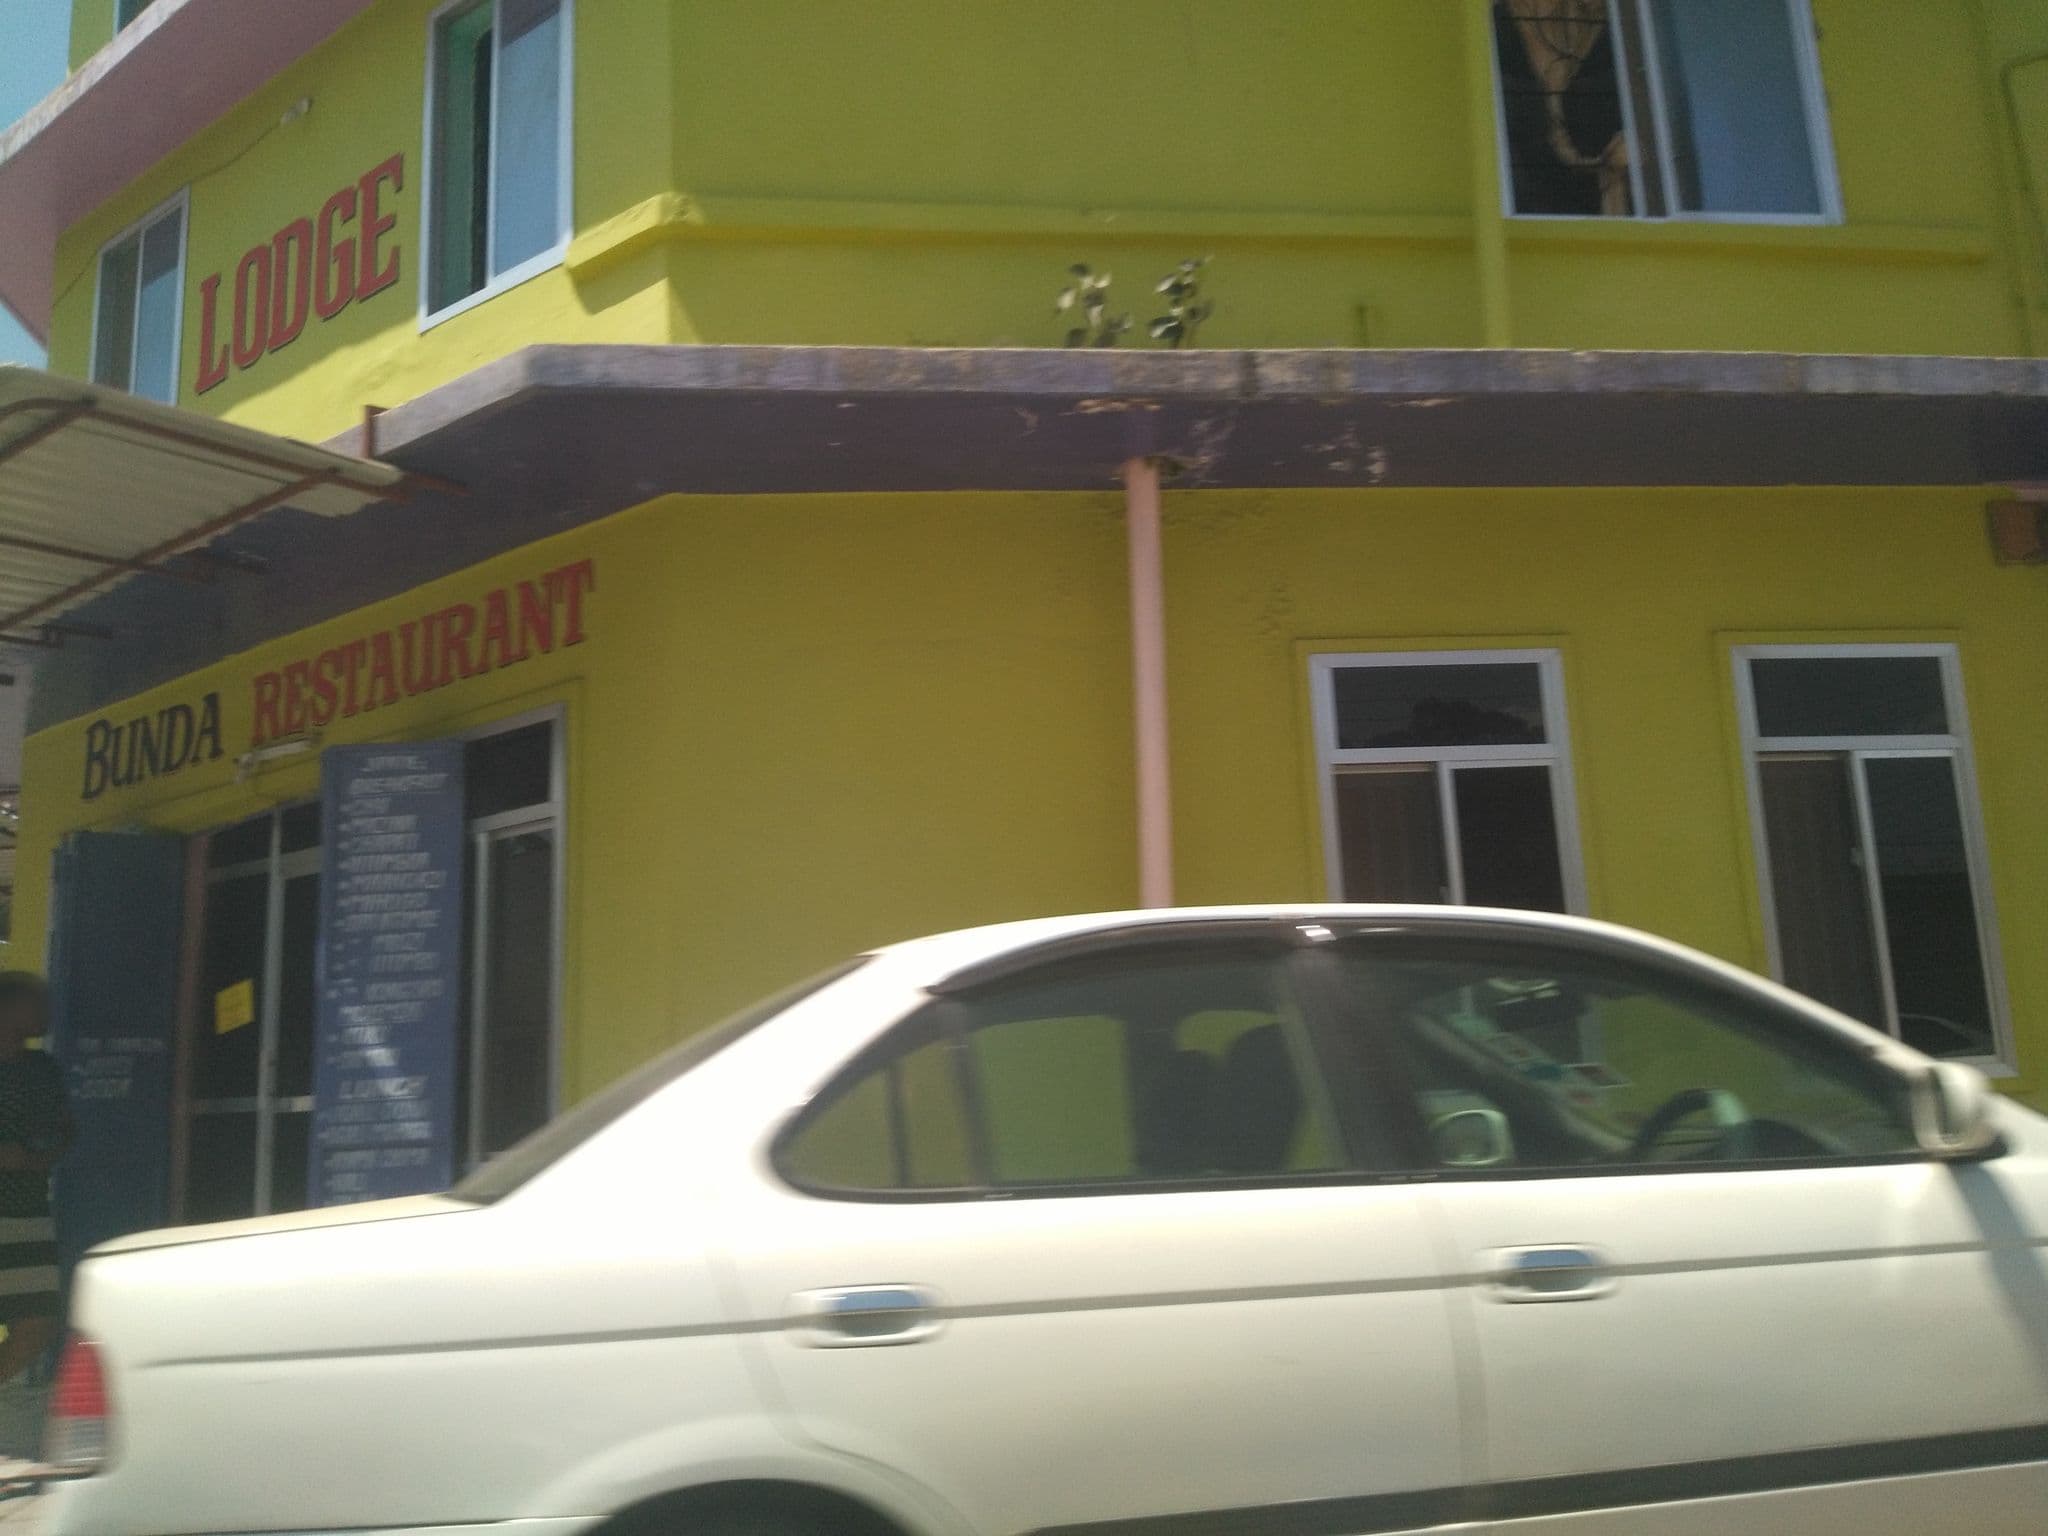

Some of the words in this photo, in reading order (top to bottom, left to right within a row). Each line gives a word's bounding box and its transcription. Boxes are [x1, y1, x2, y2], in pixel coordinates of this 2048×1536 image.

[195, 151, 404, 395] LODGE
[82, 693, 223, 800] BUNDA
[251, 559, 594, 745] RESTAURANT
